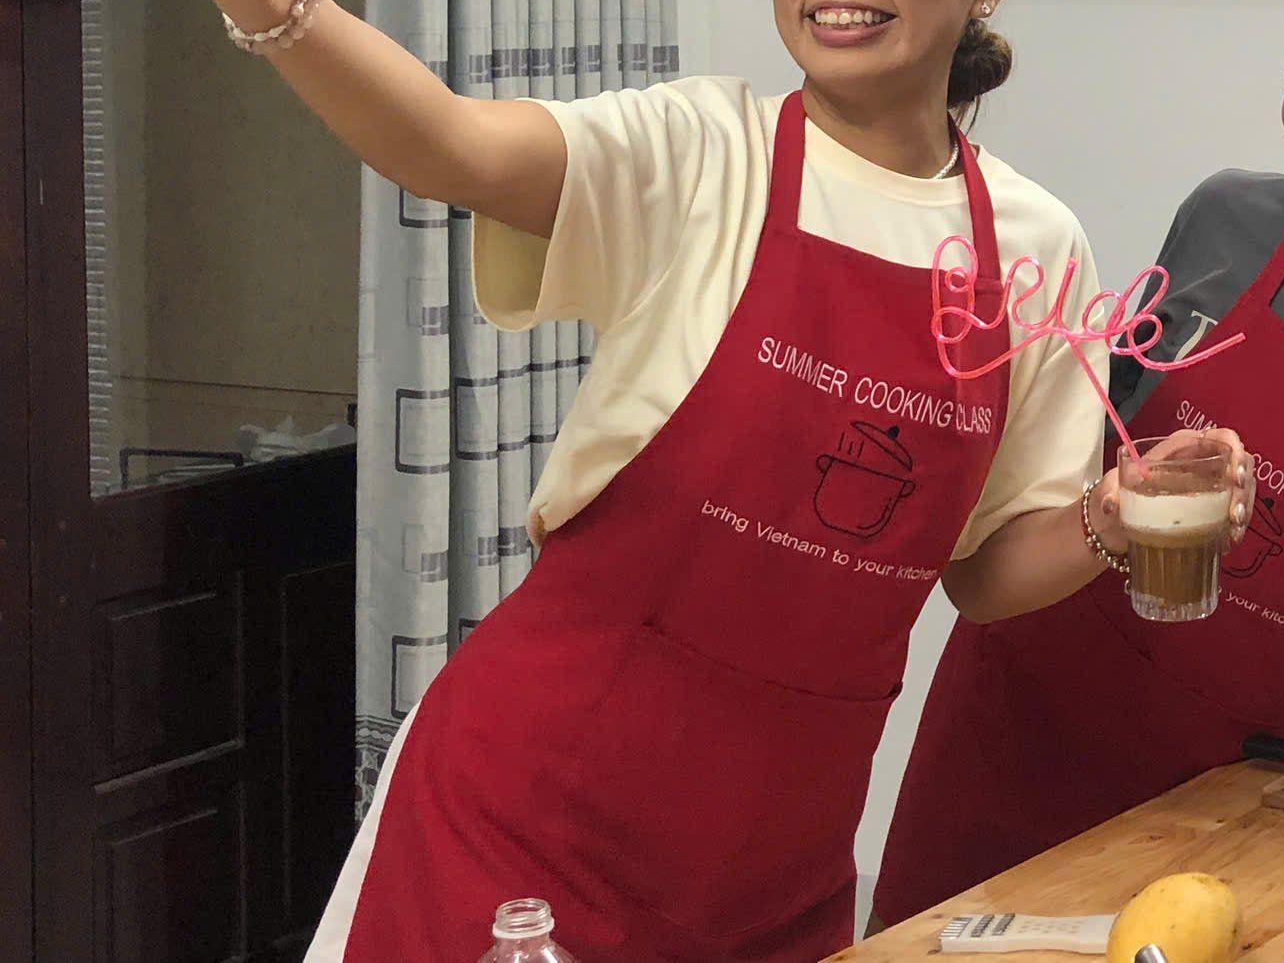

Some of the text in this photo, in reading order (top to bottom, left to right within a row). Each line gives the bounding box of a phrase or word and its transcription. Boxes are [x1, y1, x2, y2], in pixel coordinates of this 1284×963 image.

[757, 336, 992, 434] SUMMER COOKING CLASS
[701, 500, 938, 581] bring Vietnam to your kitchen
[1225, 591, 1261, 614] your
